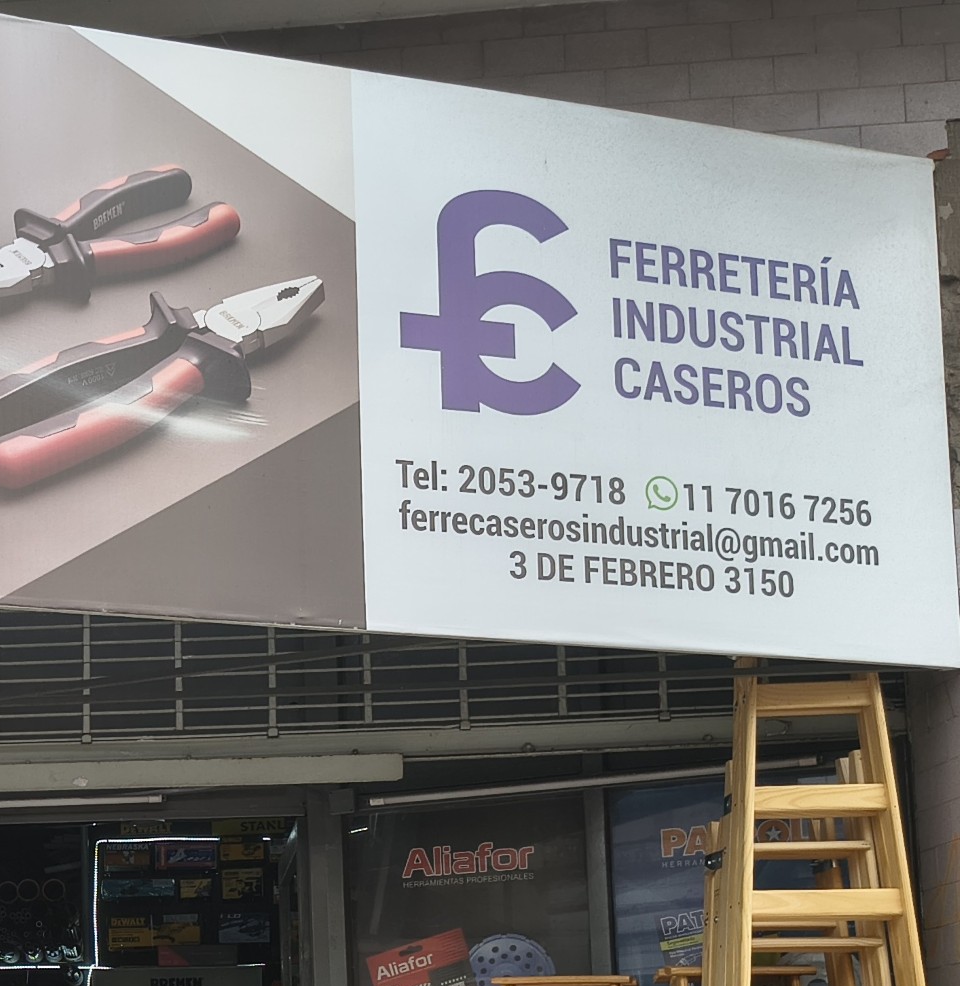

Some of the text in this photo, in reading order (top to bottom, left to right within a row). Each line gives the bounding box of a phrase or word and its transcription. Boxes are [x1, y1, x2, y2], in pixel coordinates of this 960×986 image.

[92, 203, 123, 231] BREMEN
[608, 237, 861, 310] FERRETERÍA
[611, 297, 864, 367] INDUSTRIAL
[613, 356, 811, 418] CASEROS
[395, 459, 873, 527] Tel: 2053-9718 11 7016 7256
[398, 501, 880, 567] ferrecaserosindustrial@gmail.com
[509, 550, 796, 598] 3 DE FEBRERO 3150
[240, 820, 287, 832] STANL
[402, 842, 535, 879] Aliafor
[403, 872, 535, 889] HERRAMIENTAS PROFESIONALES
[377, 954, 433, 981] Aliafor
